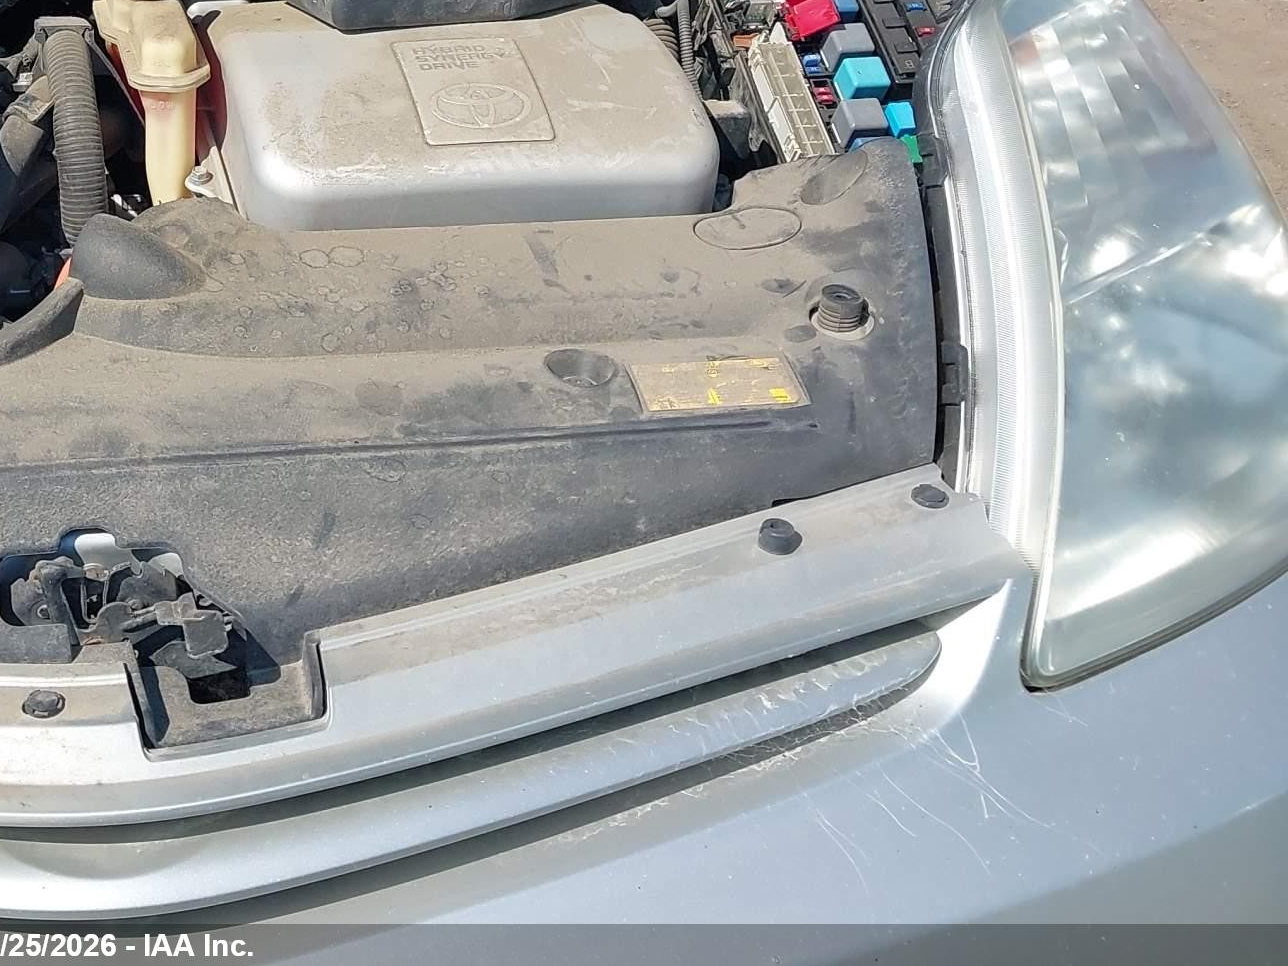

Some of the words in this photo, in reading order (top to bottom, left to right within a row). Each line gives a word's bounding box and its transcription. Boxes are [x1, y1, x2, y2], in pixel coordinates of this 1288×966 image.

[412, 44, 485, 55] HYBRID
[415, 51, 506, 63] SYNERGY
[419, 61, 481, 71] DRIVE
